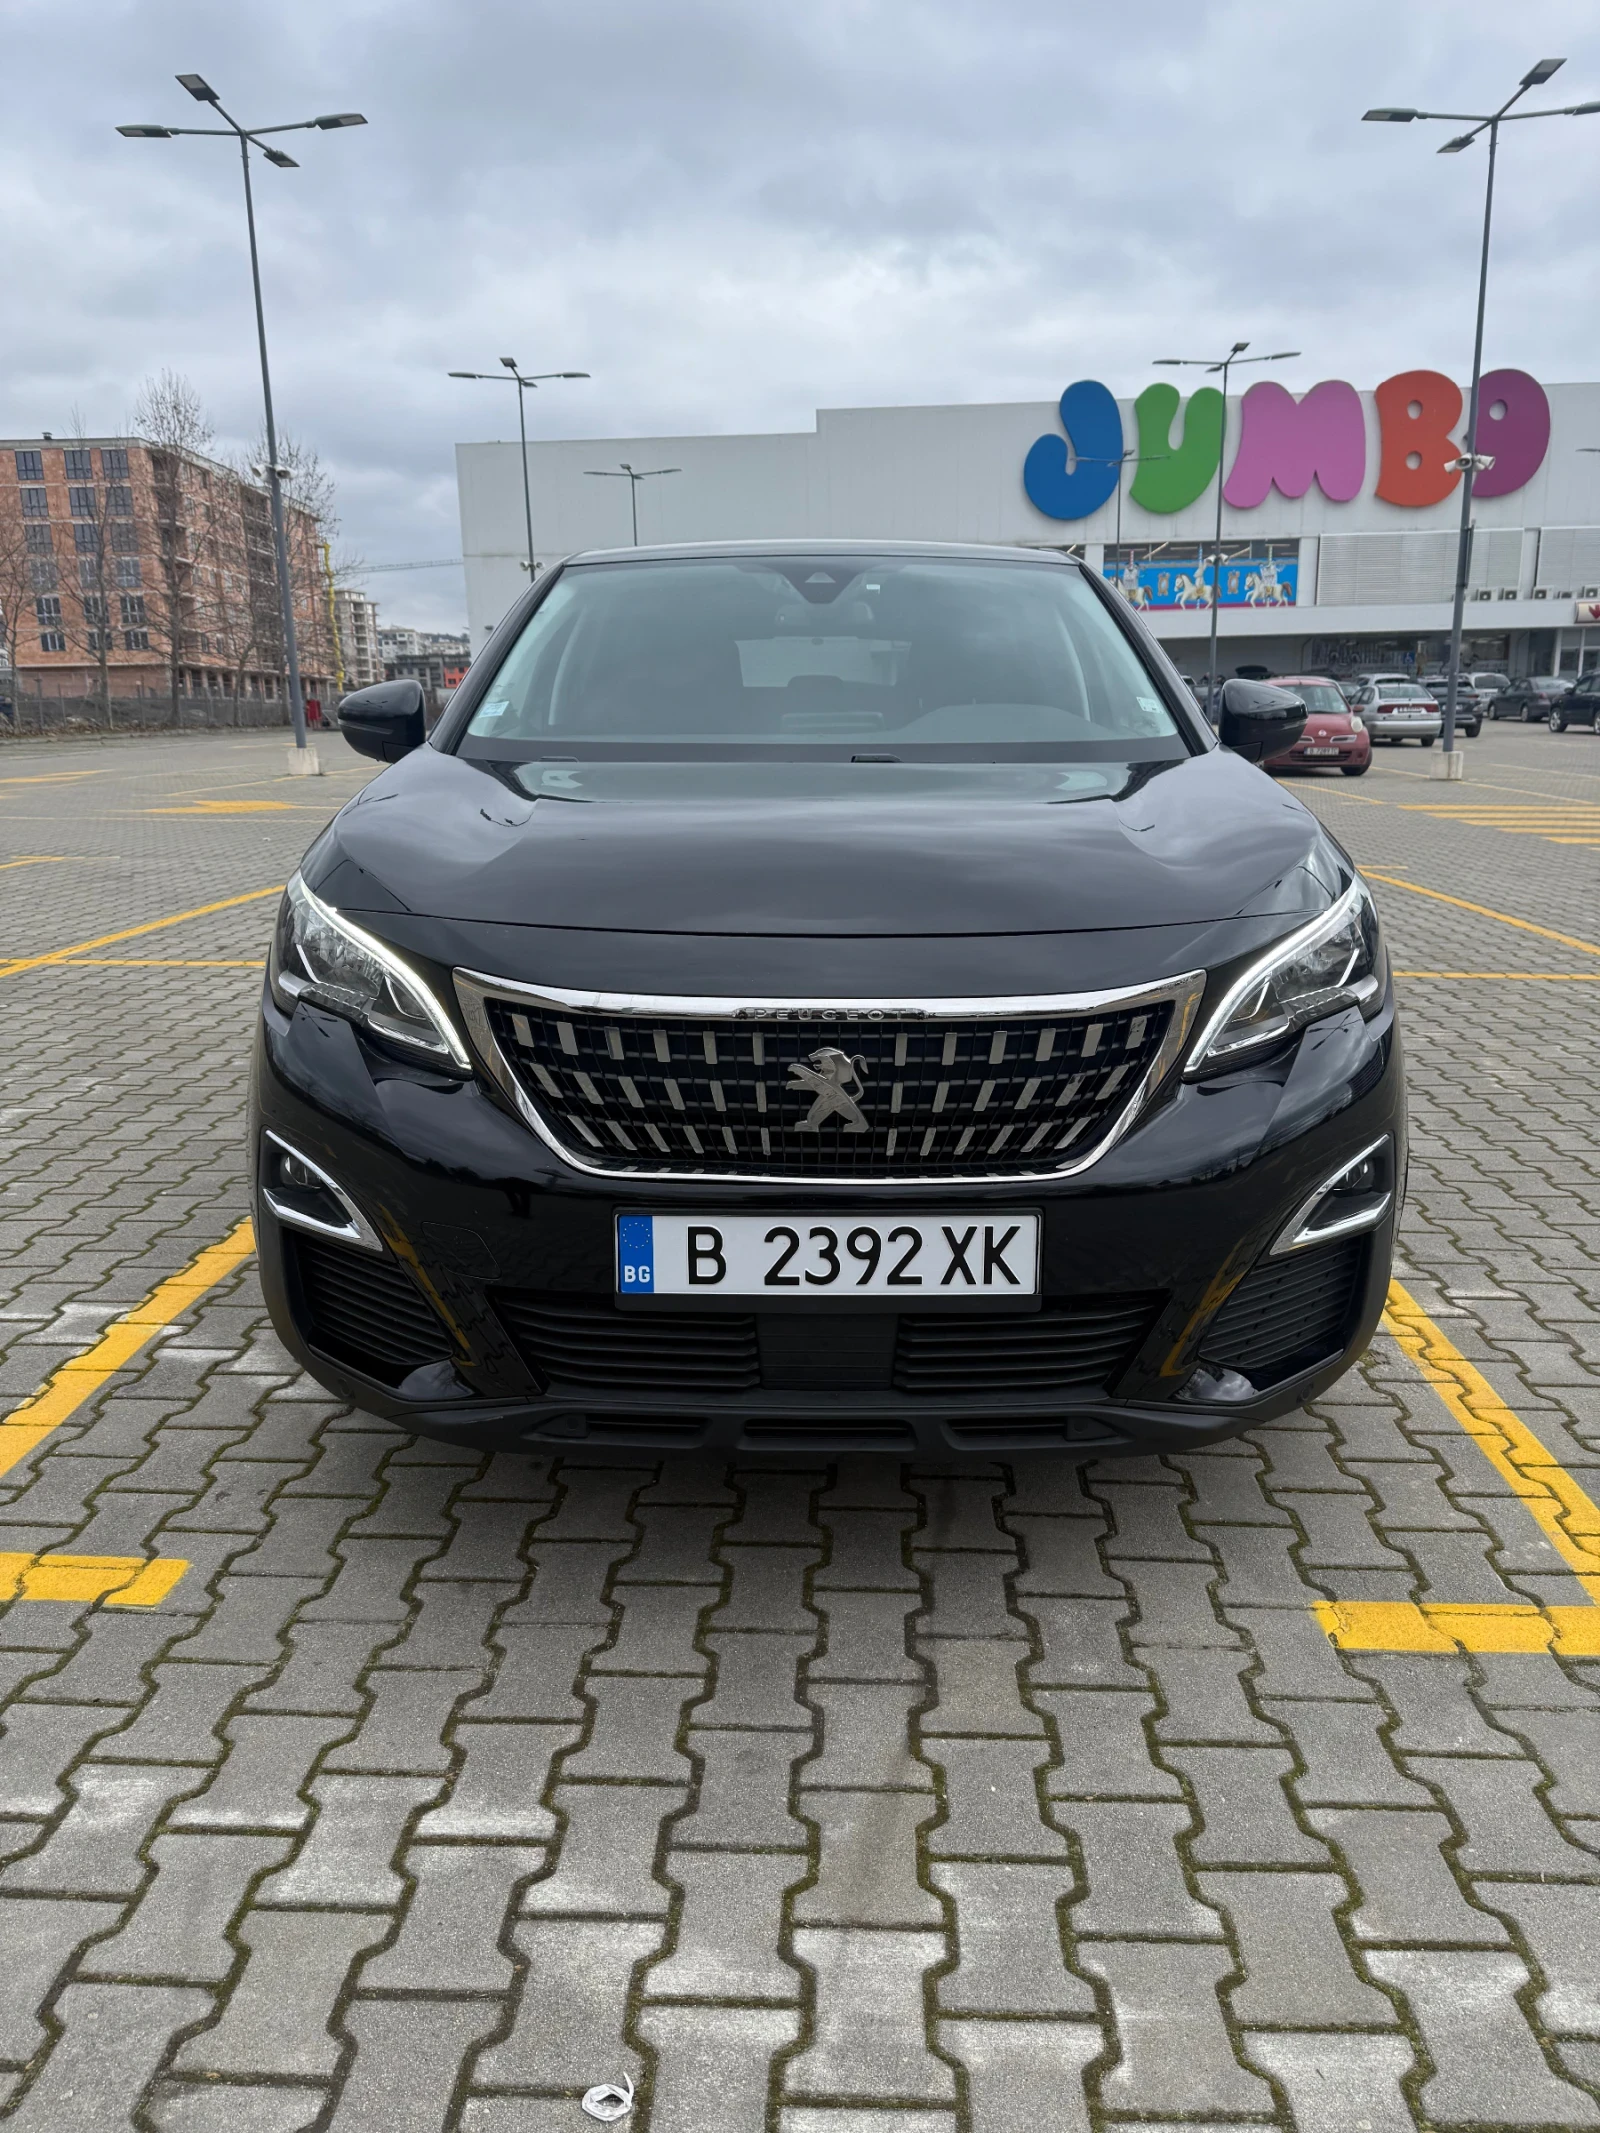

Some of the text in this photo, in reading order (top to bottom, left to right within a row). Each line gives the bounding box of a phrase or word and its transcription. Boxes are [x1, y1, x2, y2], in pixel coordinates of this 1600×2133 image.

[1024, 368, 1551, 520] JUMBO
[754, 1008, 906, 1021] PEUGEOT
[624, 1265, 651, 1285] BG
[686, 1226, 1021, 1286] B 2392 XK
